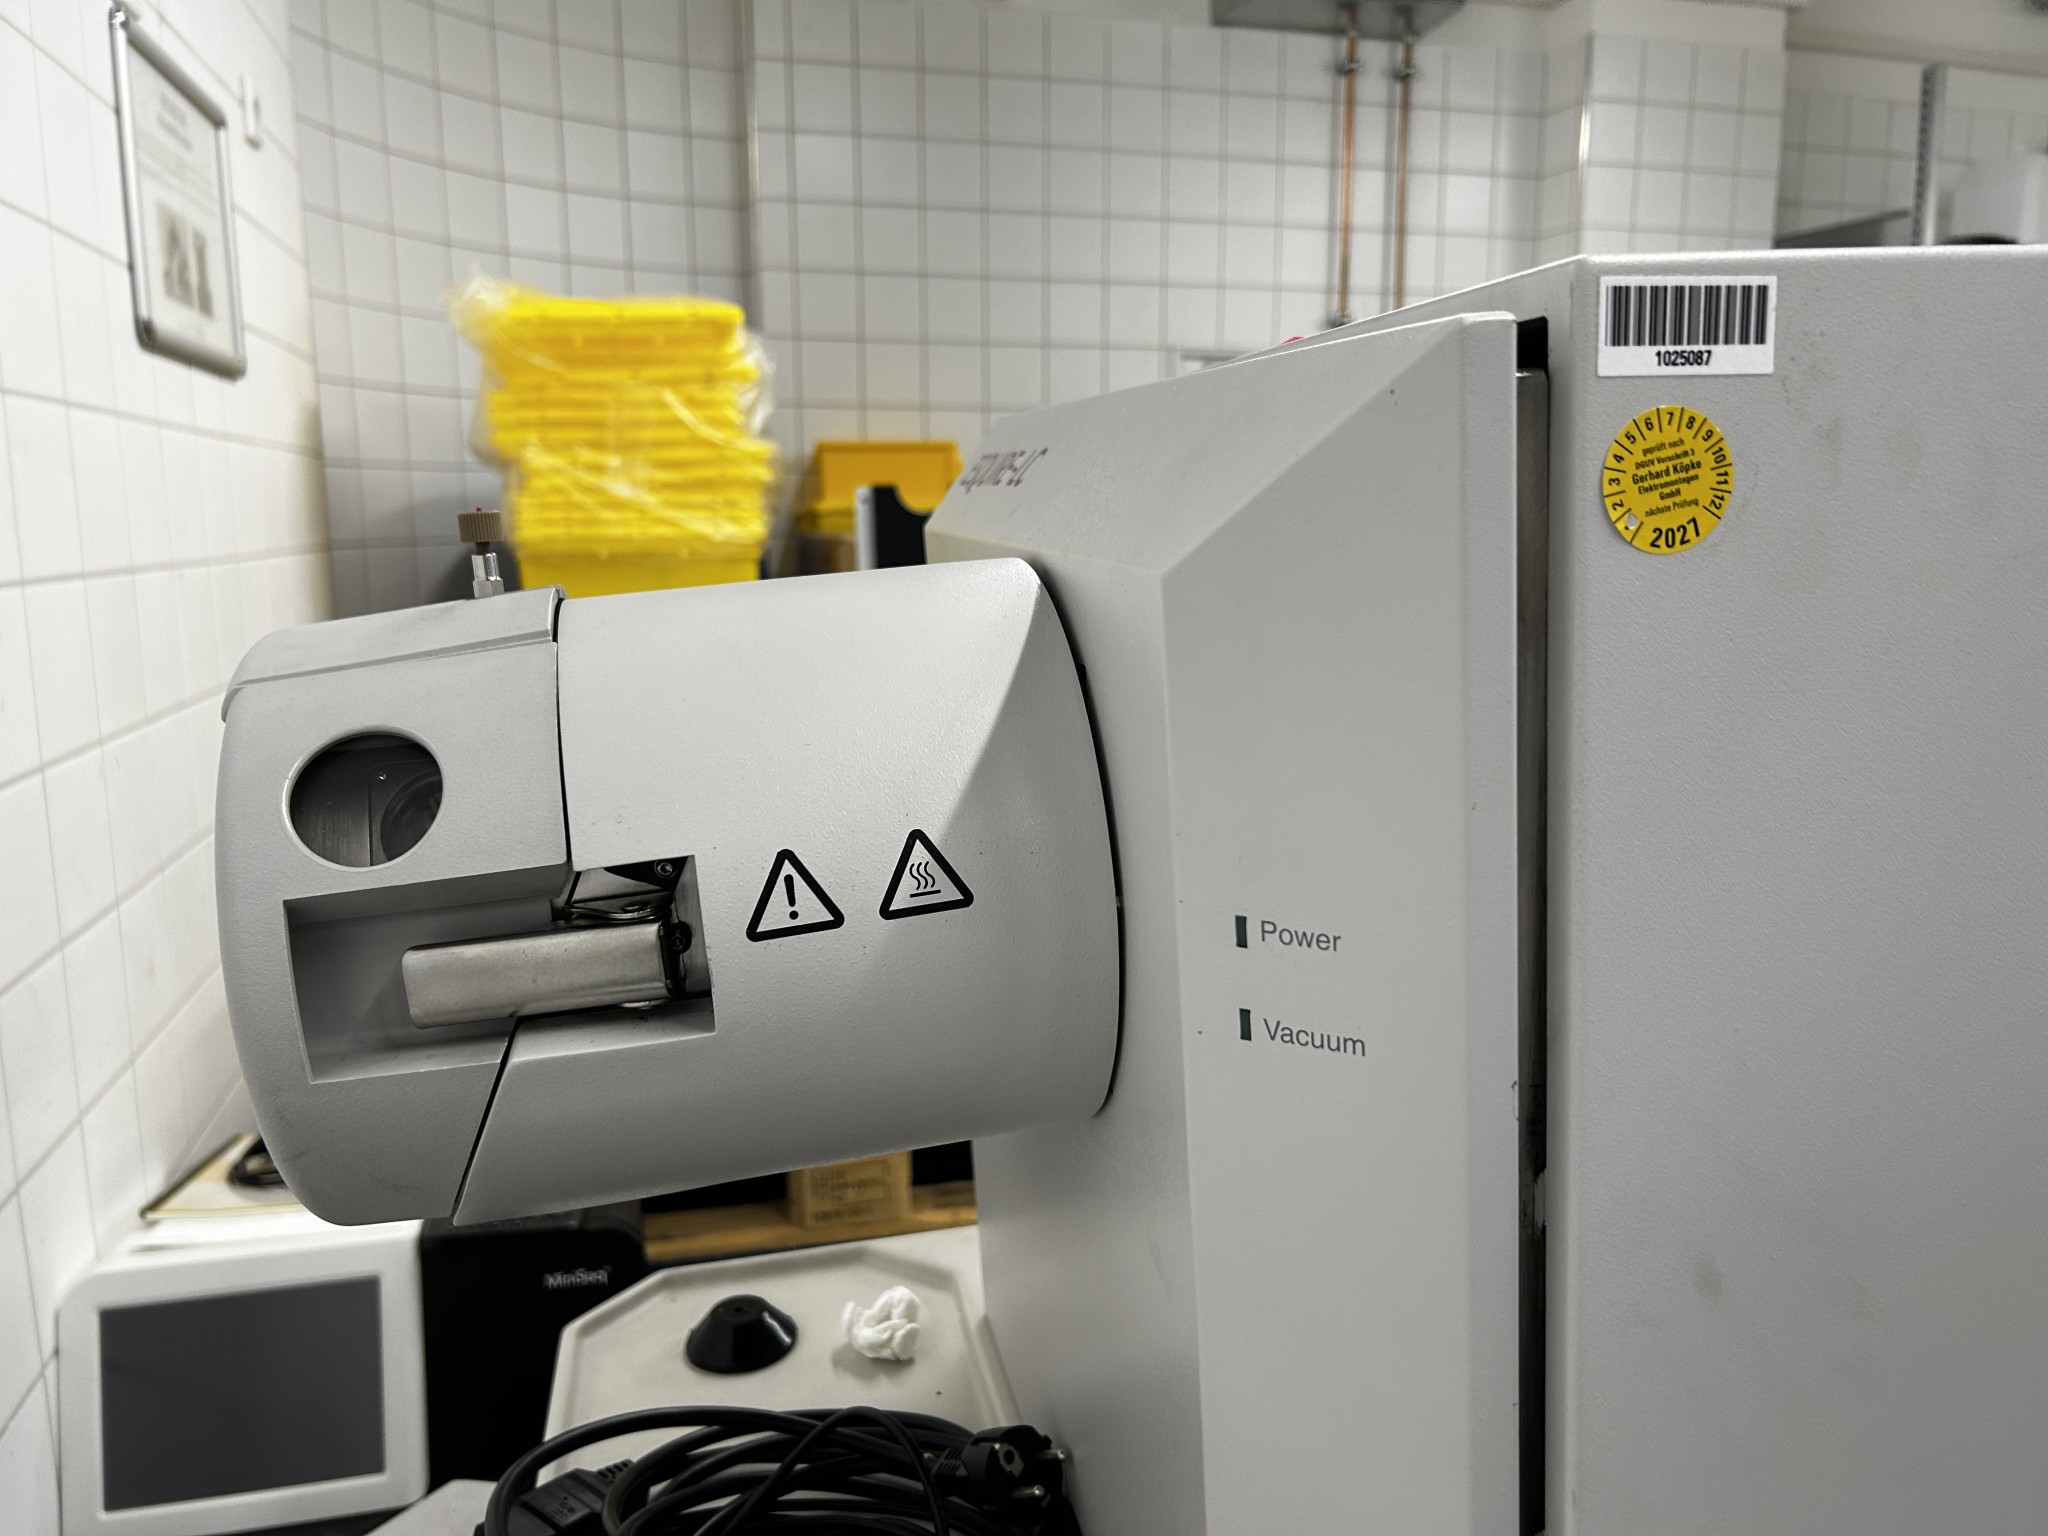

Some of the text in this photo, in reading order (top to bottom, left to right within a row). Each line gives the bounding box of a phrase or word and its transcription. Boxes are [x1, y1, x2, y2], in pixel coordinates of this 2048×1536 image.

[1655, 349, 1712, 367] 1025087
[1668, 438, 1685, 450] nach
[1608, 411, 1729, 511] 2 3 4 5 6 7 8 9 10 11 12
[1635, 448, 1695, 470] DGUV Vorschrift 3
[1631, 460, 1702, 485] Gerhard Köpke
[1638, 474, 1699, 494] Elektromontagen
[1659, 488, 1681, 500] GmbH
[1645, 498, 1699, 517] nächste Prüfung
[1649, 516, 1701, 549] 2027
[1260, 919, 1342, 951] Power
[1263, 1018, 1366, 1057] Vacuum
